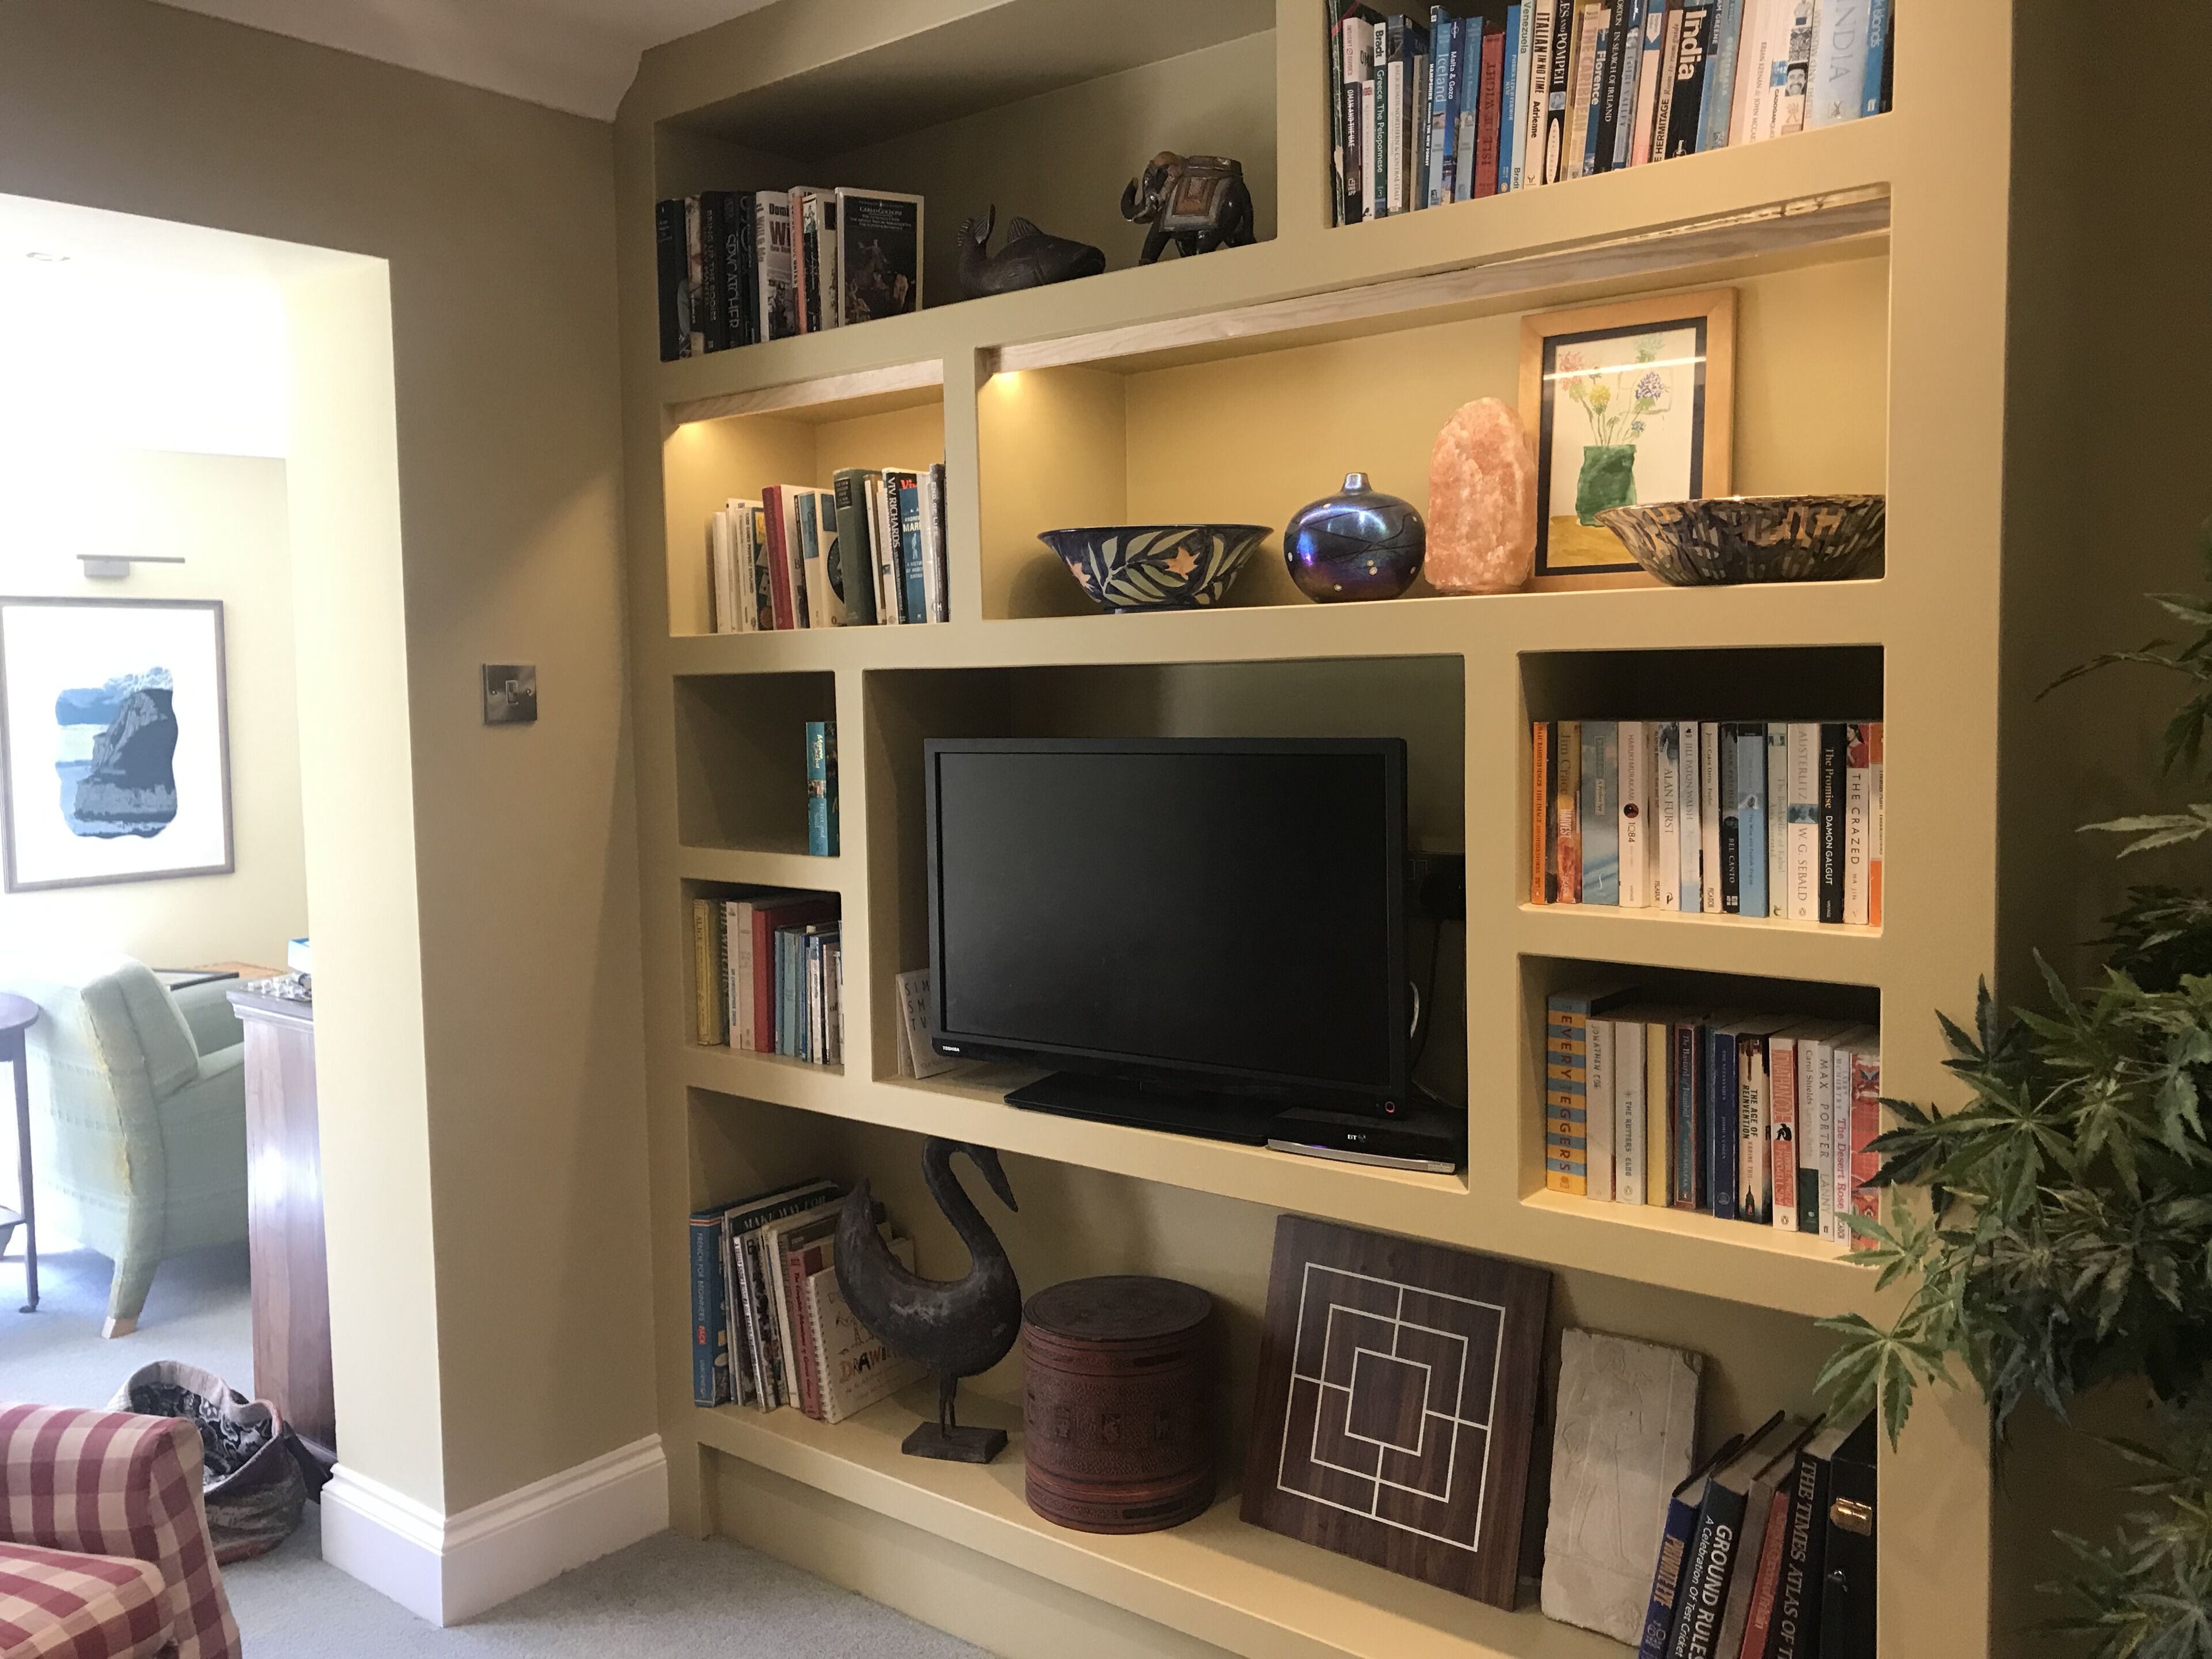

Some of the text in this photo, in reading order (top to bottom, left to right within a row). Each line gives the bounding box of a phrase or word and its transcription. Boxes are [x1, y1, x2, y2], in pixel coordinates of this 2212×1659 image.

[1375, 30, 1384, 58] Bradt
[1520, 2, 1532, 54] Venezuela
[1534, 12, 1551, 94] ITALIAN IN NO TIME
[1582, 29, 1596, 52] THE
[1677, 10, 1707, 81] India
[1711, 14, 1722, 44] GREENE
[1807, 9, 1822, 85] AND MUSEUM
[1434, 54, 1449, 103] Iceland
[1449, 51, 1457, 72] Malta
[1553, 33, 1568, 85] POMPEII
[1590, 50, 1606, 106] Florence
[1604, 31, 1621, 122] IN SEARCH OF IRELAND
[1753, 41, 1767, 115] BRIAN KEENAN JOHN
[1376, 70, 1385, 102] Greece:
[1448, 81, 1456, 100] Gozo
[1574, 58, 1594, 132] CARIBBEAN
[1619, 89, 1631, 127] VALLEY
[1654, 99, 1669, 154] HERMITAGE
[1669, 24, 1679, 43] guide
[1482, 62, 1497, 166] ISLE OF WIGHT
[1531, 101, 1541, 138] Adrienne
[1376, 122, 1384, 173] Peloponnese
[1513, 167, 1521, 189] Bradt
[706, 209, 714, 243] BRING
[707, 244, 715, 258] UP
[709, 284, 717, 322] BODIES
[725, 233, 740, 329] SPYCATCHER
[888, 476, 897, 496] VIV
[889, 497, 900, 548] RICHARDS
[1560, 732, 1571, 795] Jim Crace
[1685, 743, 1694, 757] JILL
[1685, 760, 1694, 787] PATON
[1797, 730, 1808, 801] AUSTERLITZ
[1627, 762, 1635, 801] MURAKAMI
[1664, 767, 1674, 835] ALAN FURST
[1685, 790, 1694, 820] WALSH
[1559, 808, 1572, 839] HARVEST
[1627, 822, 1636, 843] 1Q84
[1777, 777, 1785, 873] The Bookseller of Kabul
[1824, 747, 1835, 885] The Promise DAMON GALGUT
[1850, 772, 1861, 866] THE CRAZED
[1798, 827, 1808, 901] W. G. SEBALD
[1851, 873, 1859, 900] HA JIN
[1560, 1015, 1573, 1079] EVERY
[1592, 1024, 1601, 1089] JONATHAN COE
[1682, 1035, 1690, 1047] The
[1682, 1047, 1691, 1077] Bastard
[1682, 1086, 1691, 1118] Istanbul
[1772, 1050, 1792, 1121] JONATHAN COE
[1805, 1049, 1814, 1105] Carol Shields
[1559, 1096, 1572, 1172] EGGERS
[1742, 1084, 1751, 1140] REINVENTION
[1750, 1089, 1759, 1138] THE AGE OF
[1819, 1058, 1831, 1217] MAX PORTER LANNY
[1774, 1149, 1785, 1205] MAXWELL SIM
[1837, 1118, 1847, 1209] The Desert Rose
[697, 1279, 705, 1321] BEGINNERS
[798, 1313, 806, 1347] Adventures
[1798, 1461, 1817, 1501] THE
[1790, 1502, 1812, 1563] TIMES
[1658, 1534, 1685, 1588] PRIVATE
[1675, 1515, 1714, 1658] A Celebration Of Test Cricket
[1701, 1525, 1733, 1607] GROUND
[1653, 1583, 1675, 1610] EYE
[1782, 1563, 1804, 1619] ATLAS
[1781, 1619, 1796, 1646] OF
